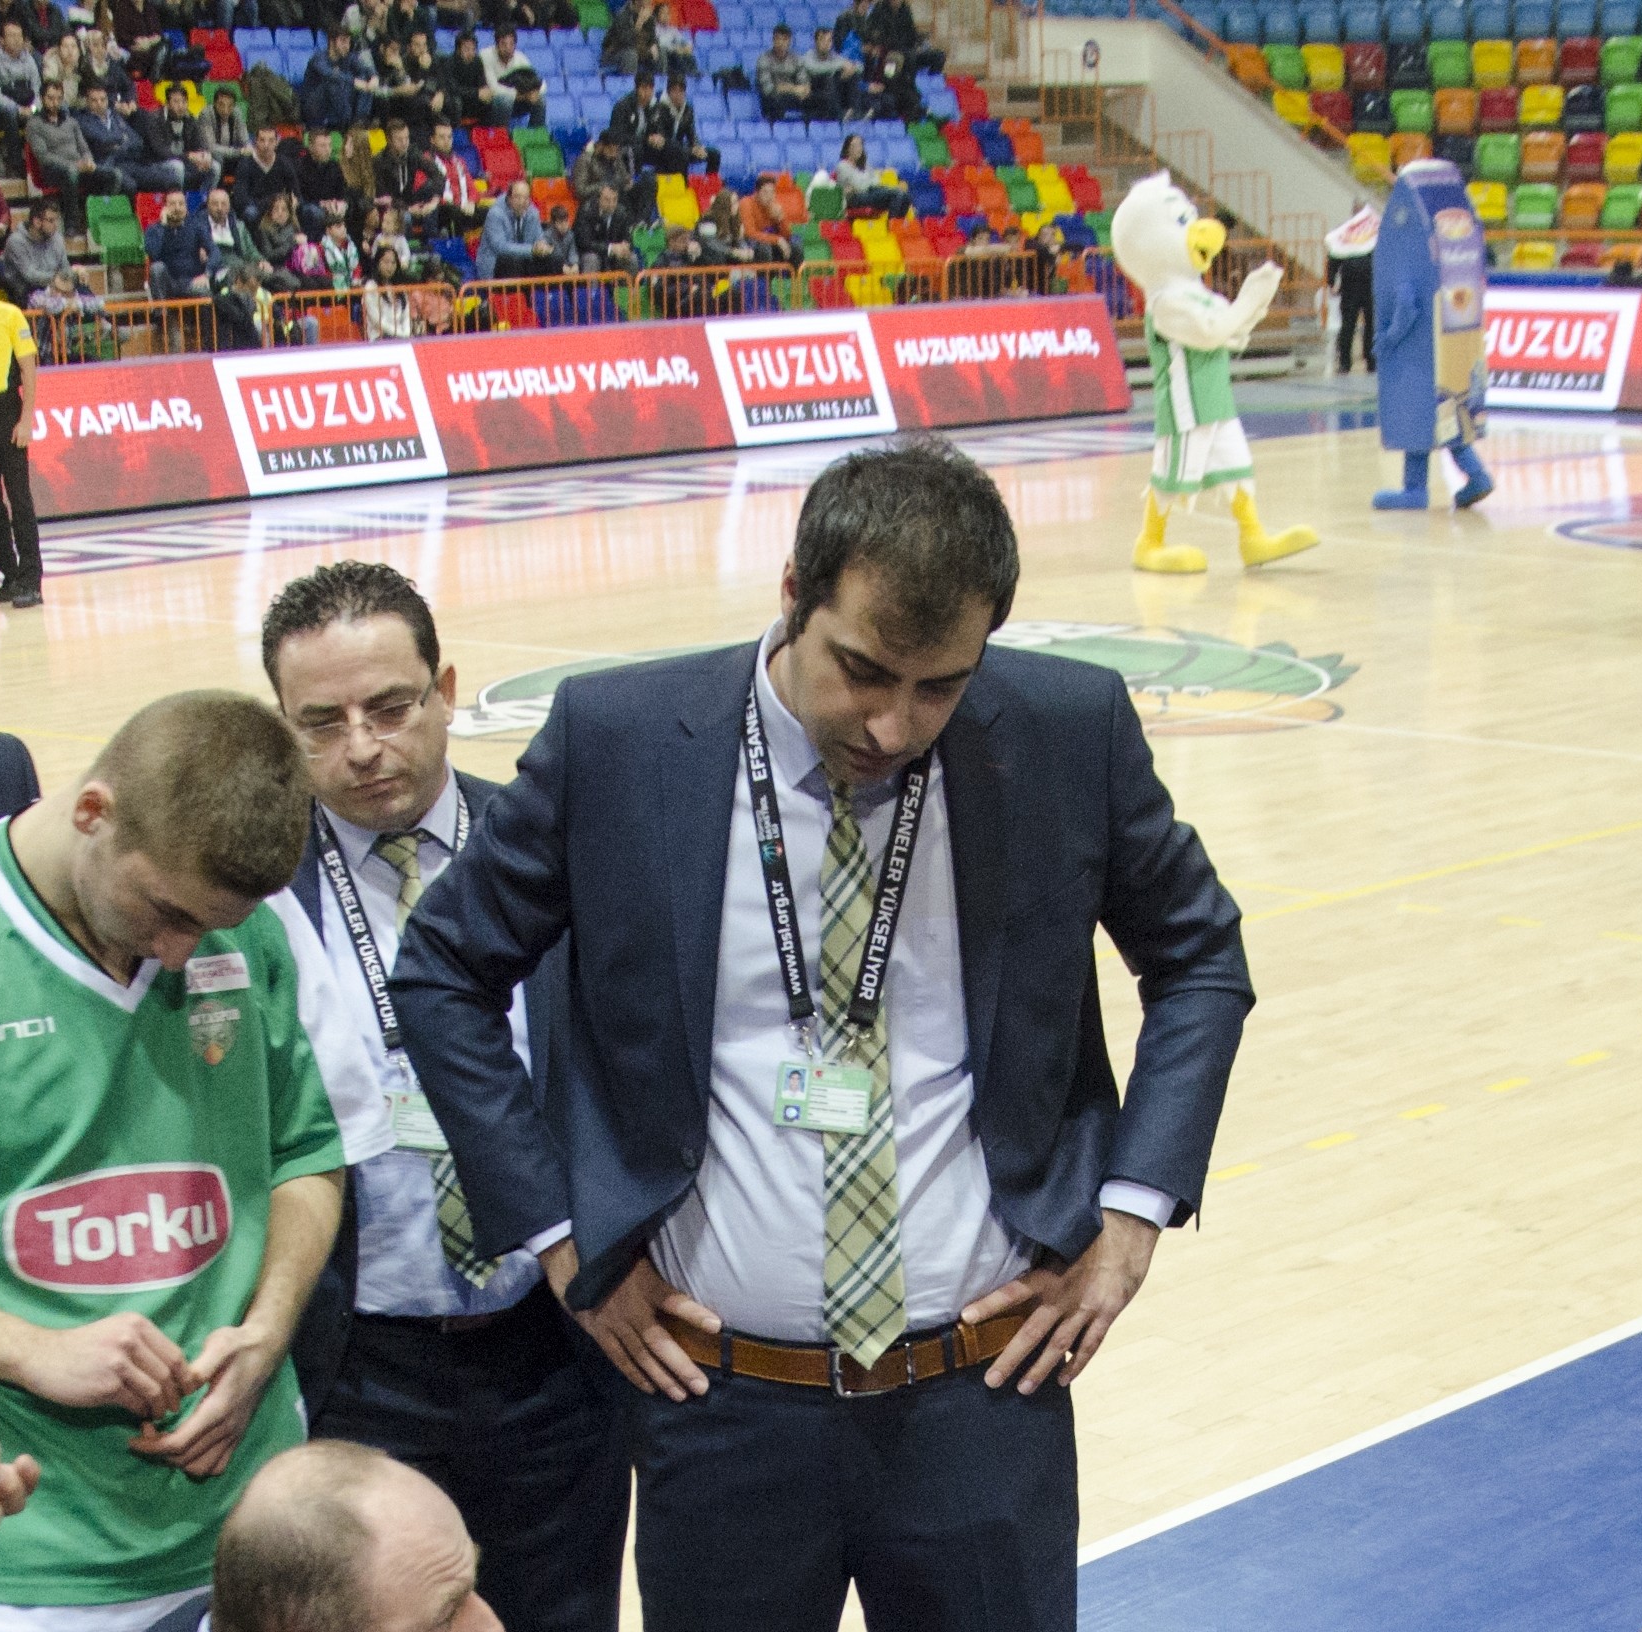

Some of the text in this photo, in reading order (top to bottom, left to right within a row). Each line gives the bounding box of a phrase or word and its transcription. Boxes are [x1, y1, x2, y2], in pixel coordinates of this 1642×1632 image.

[736, 342, 864, 391] HUZUR
[894, 333, 1000, 369] HUZURLU
[447, 355, 700, 403] HUZURLU YAPILAR,
[251, 378, 407, 433] HUZUR
[751, 403, 807, 425] EMLAK
[268, 447, 336, 472] EMLAK
[886, 772, 924, 883] EFSANELER
[323, 849, 367, 935] EFSANELER
[771, 879, 803, 996] www.bsl.org.tr
[35, 1192, 219, 1267] Torku
